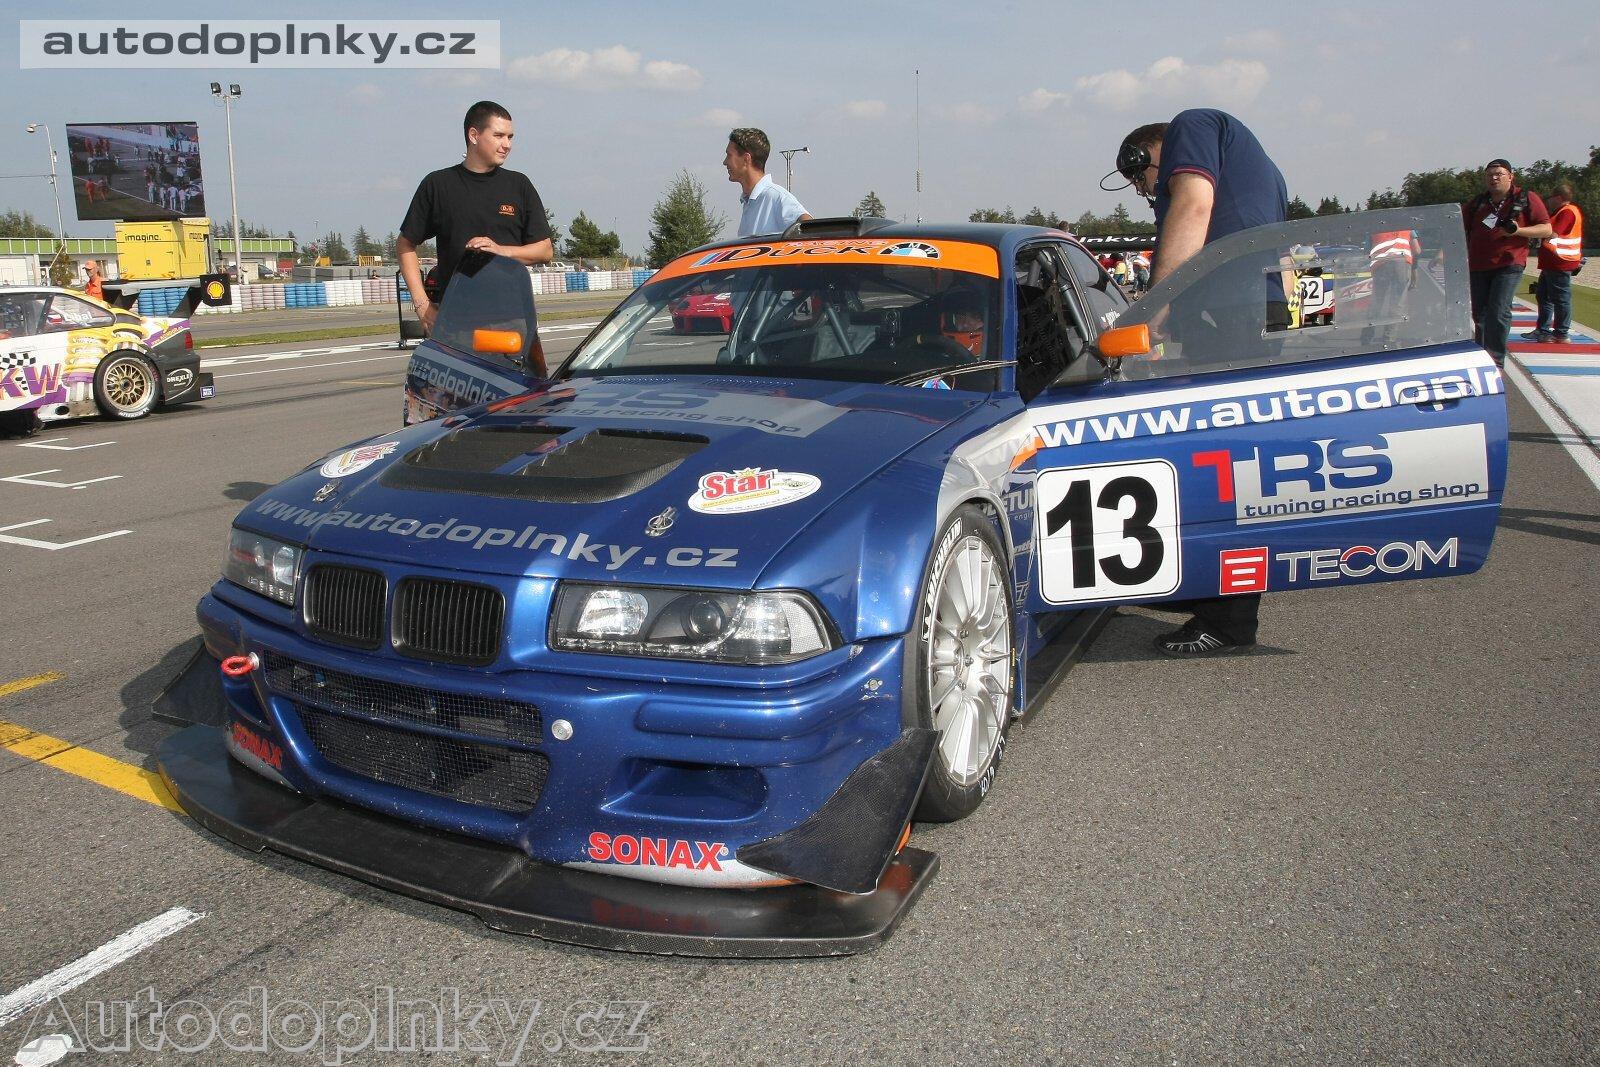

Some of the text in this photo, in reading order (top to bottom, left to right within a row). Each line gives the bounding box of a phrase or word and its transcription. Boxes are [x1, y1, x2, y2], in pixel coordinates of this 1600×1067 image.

[717, 414, 804, 435] shop
[705, 473, 773, 499] Star
[1191, 433, 1394, 503] TRS
[1244, 481, 1481, 517] tuning racing shop
[253, 496, 740, 571] www.autodoplnky.cz
[1046, 475, 1165, 589] 13
[1275, 536, 1459, 583] TECOM
[588, 831, 726, 872] SONAX
